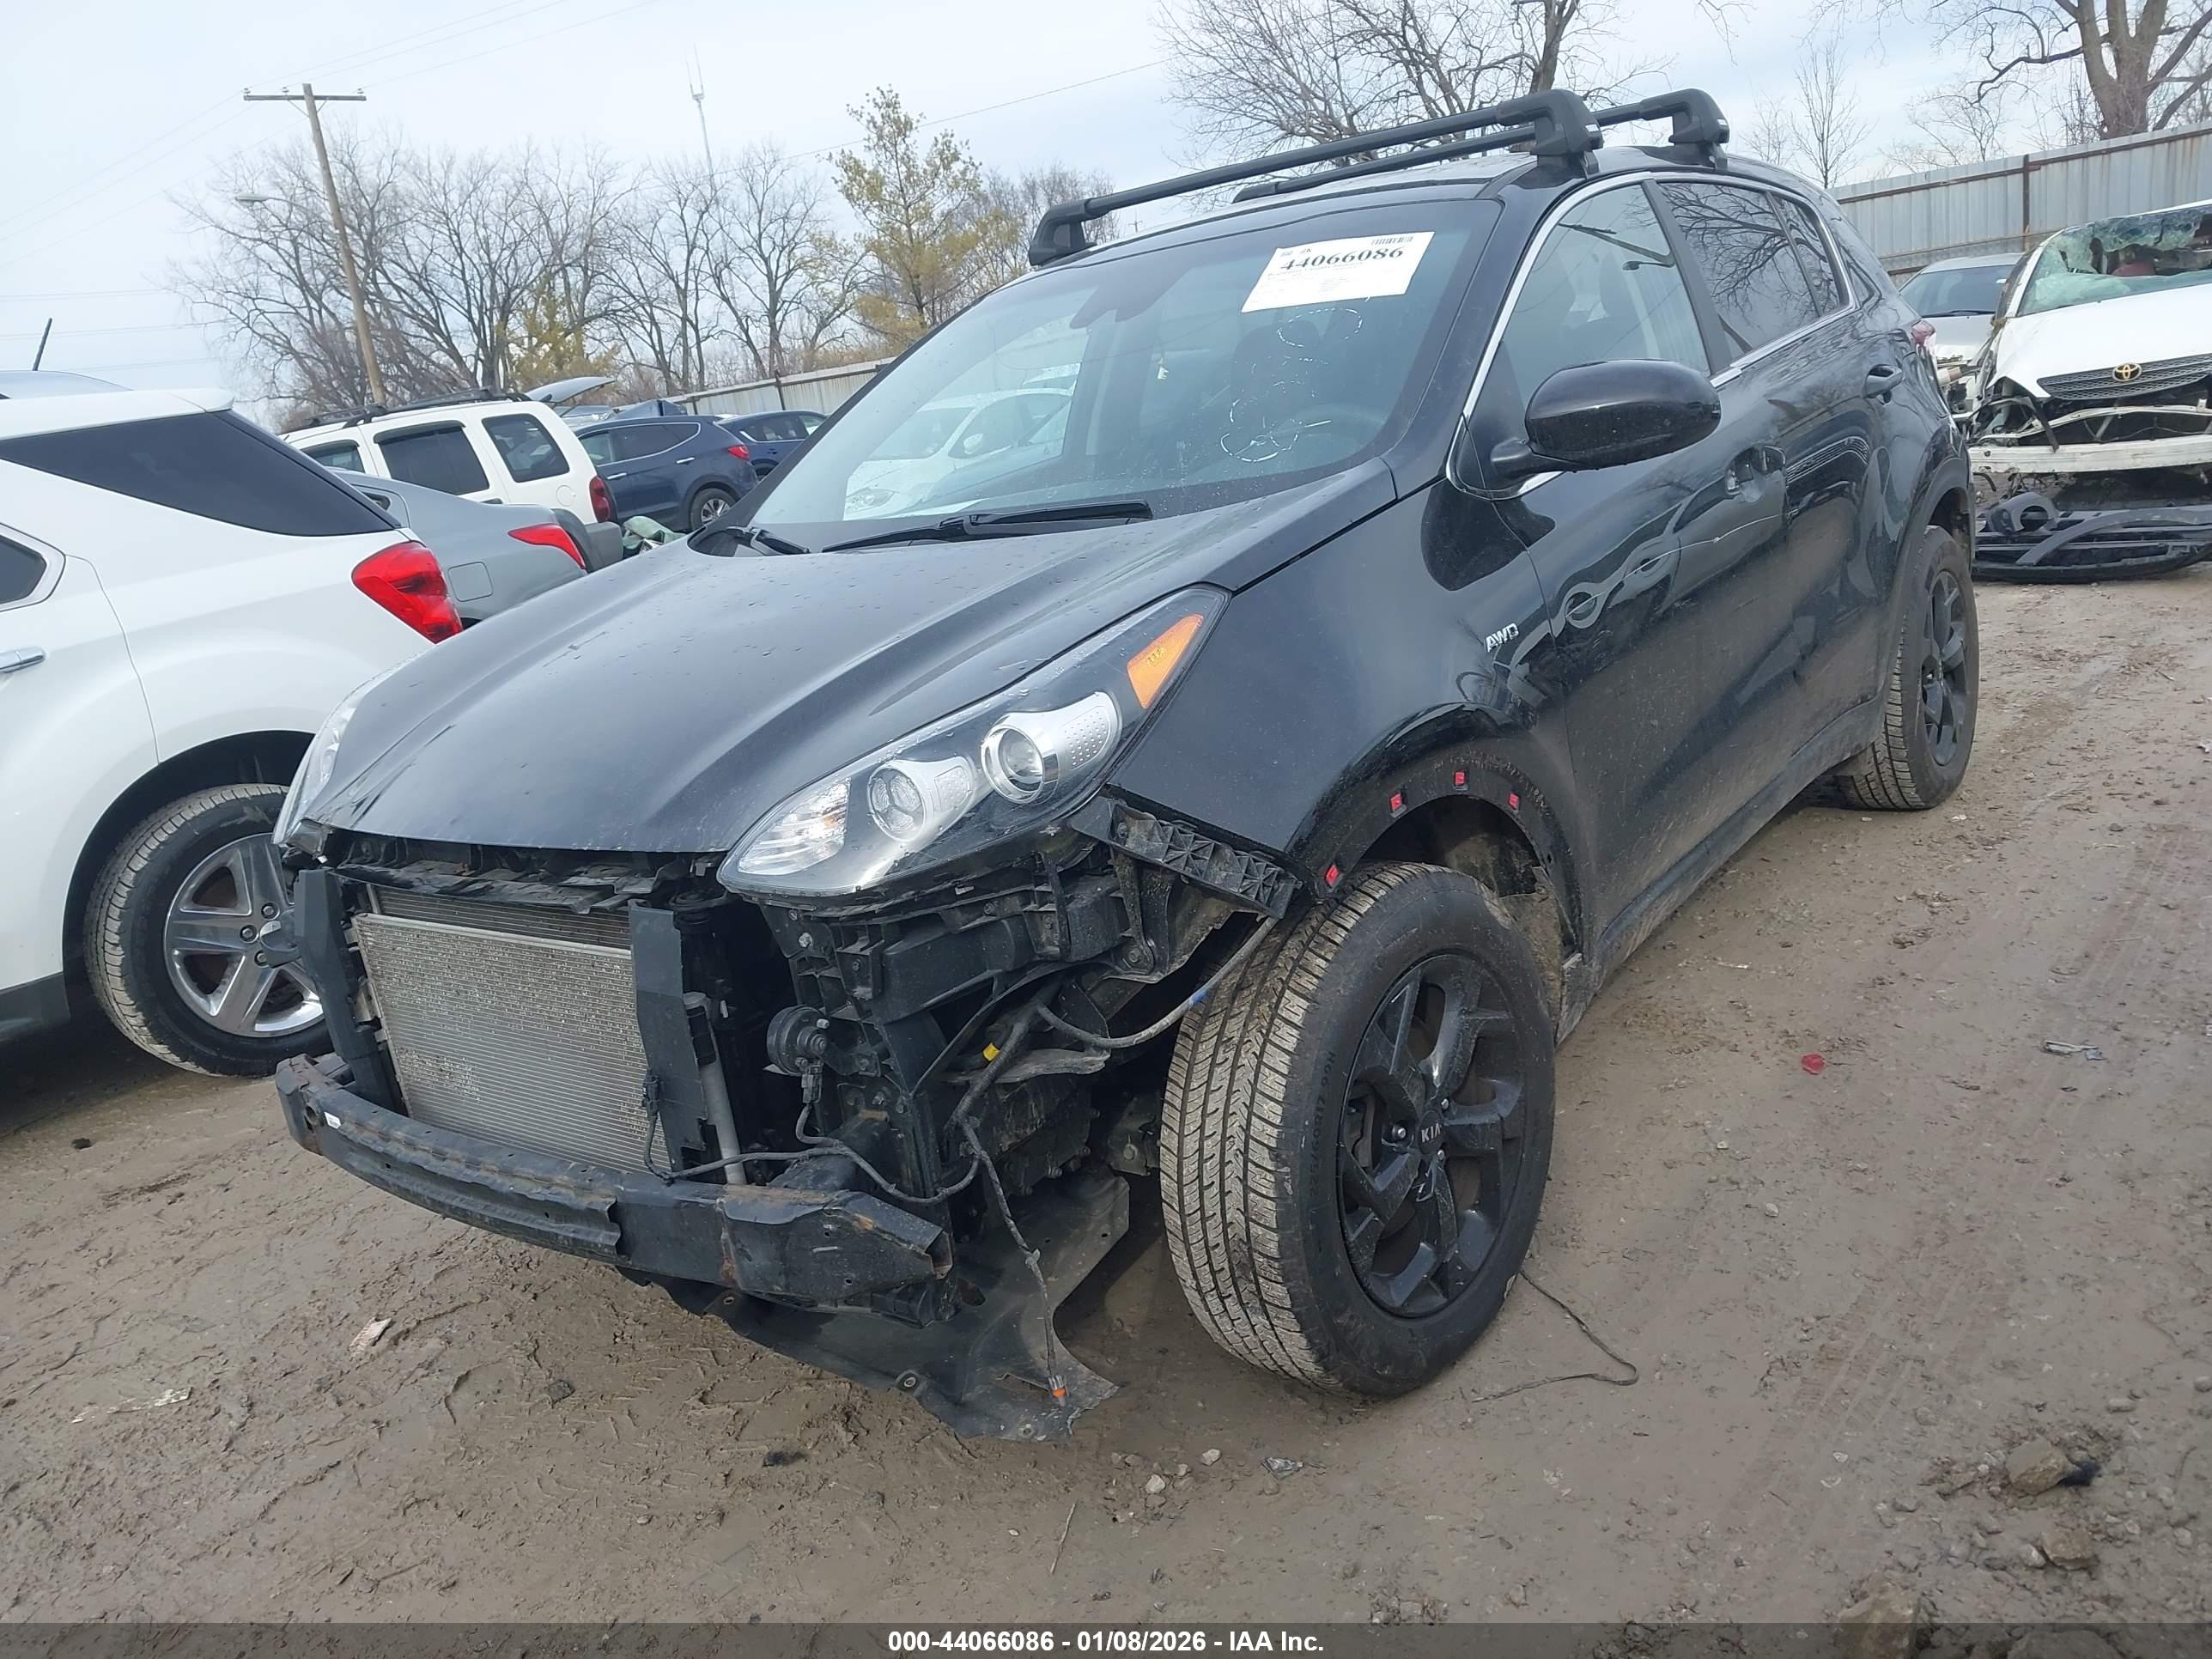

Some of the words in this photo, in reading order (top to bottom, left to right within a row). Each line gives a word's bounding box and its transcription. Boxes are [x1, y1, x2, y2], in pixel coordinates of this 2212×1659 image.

[1280, 246, 1404, 270] 44066086
[1486, 623, 1519, 653] AWD
[1421, 1122, 1442, 1143] KIA
